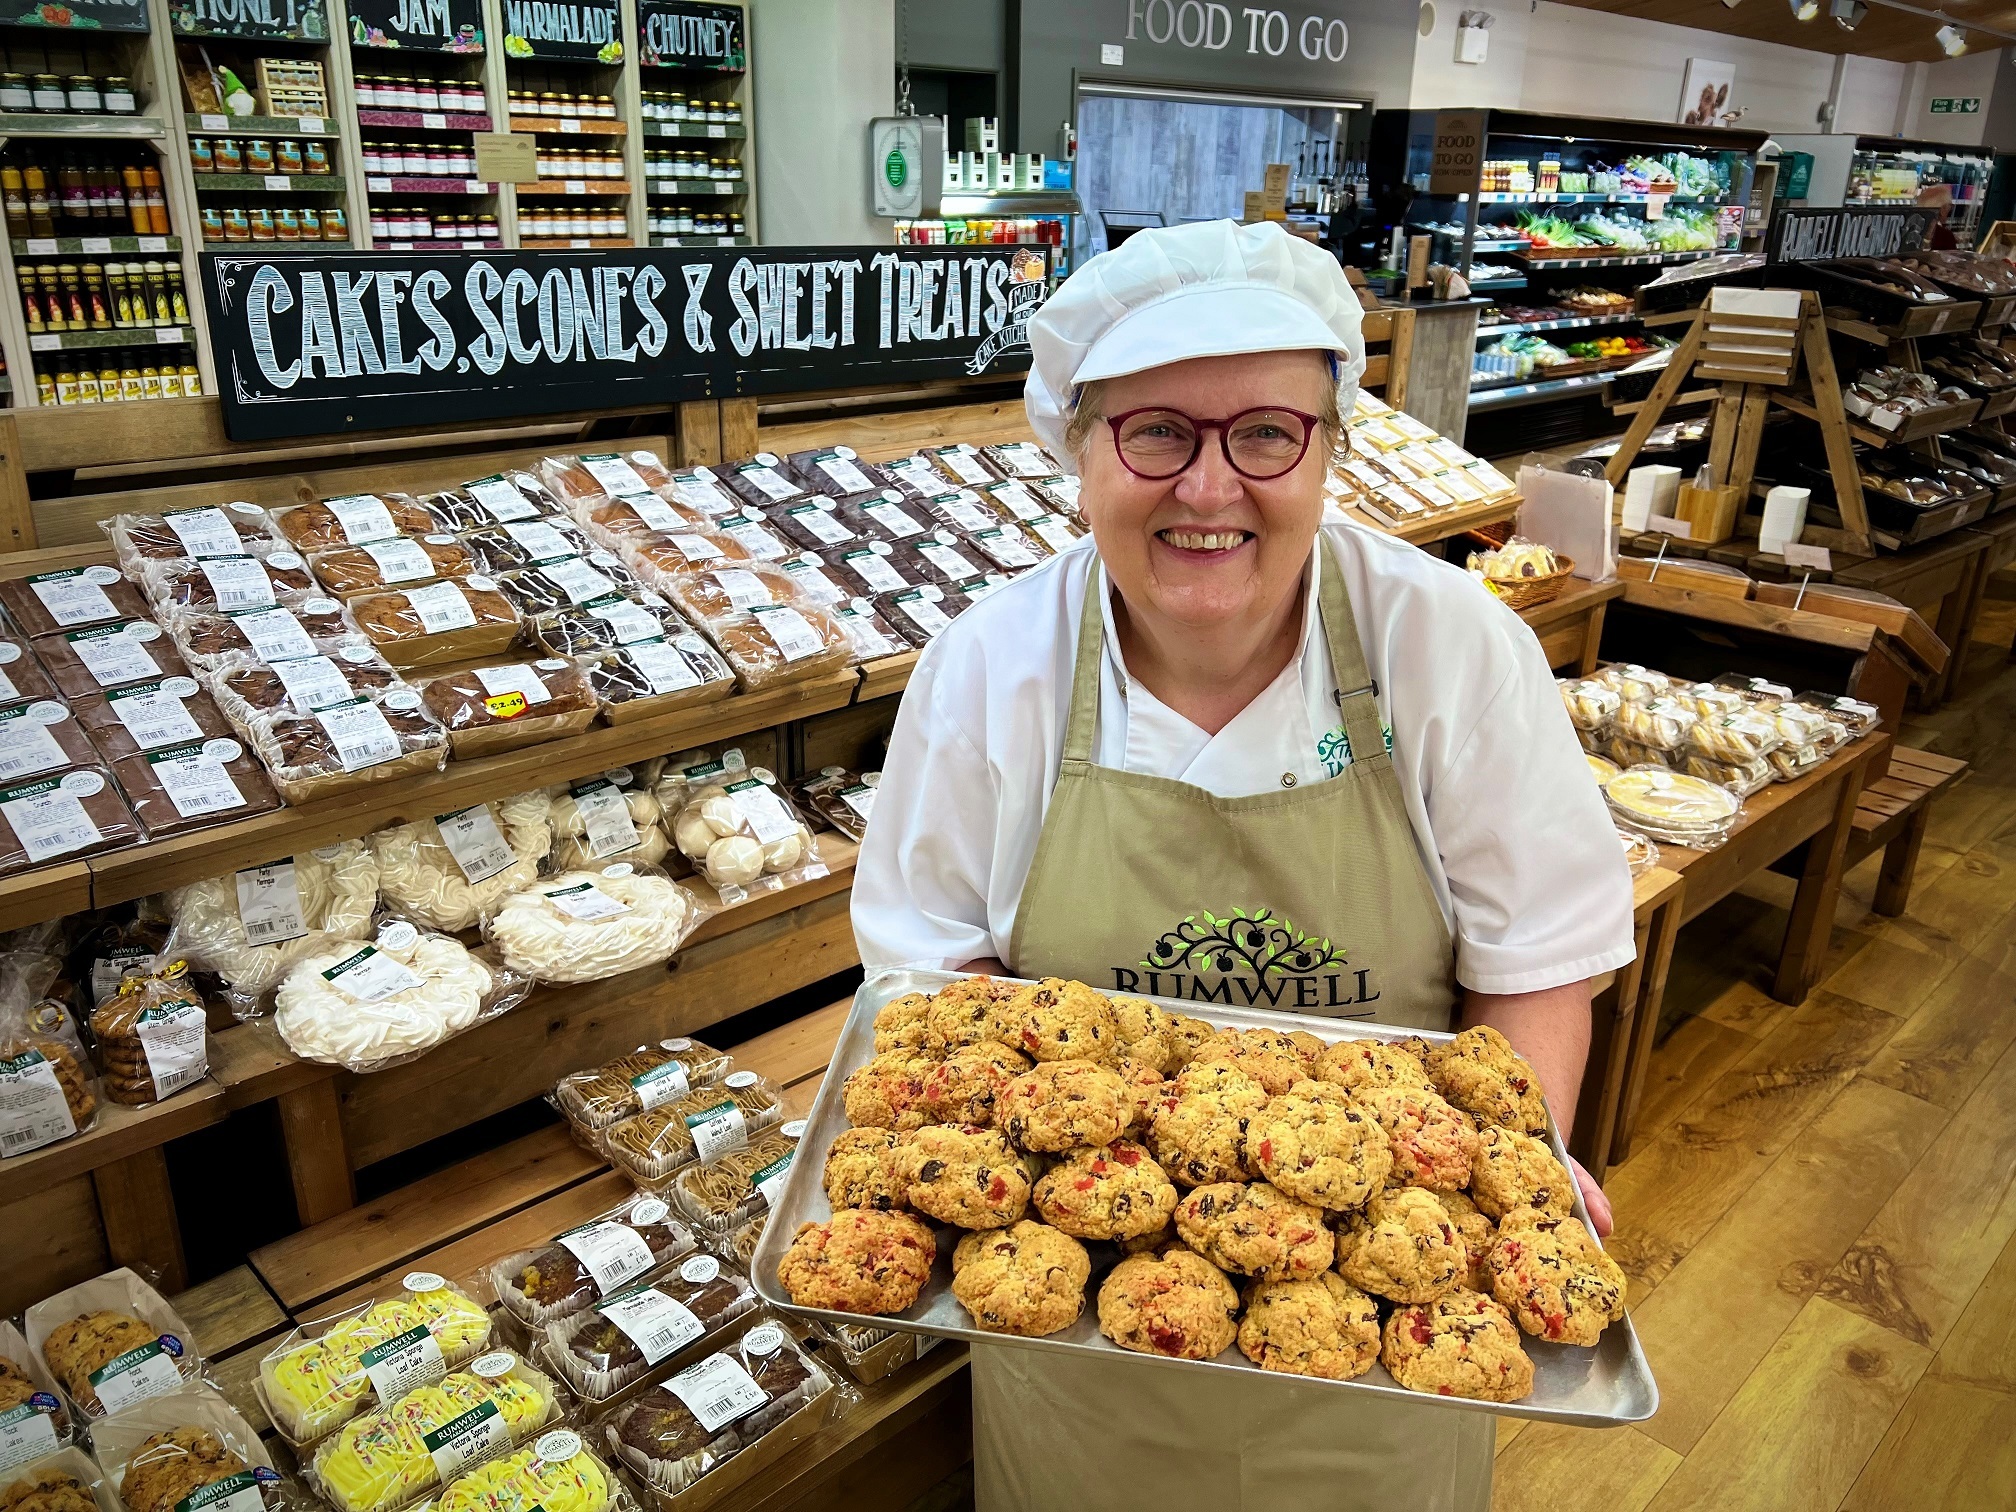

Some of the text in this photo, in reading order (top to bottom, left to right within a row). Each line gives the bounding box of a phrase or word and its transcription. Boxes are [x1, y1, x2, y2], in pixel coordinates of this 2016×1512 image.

[388, 0, 452, 37] JAM
[503, 0, 619, 45] MARMALADE
[646, 12, 736, 58] CHUTNEY
[1124, 0, 1349, 63] FOOD TO GO
[1436, 135, 1476, 149] FOOD
[1435, 152, 1474, 166] TO GO
[1013, 284, 1038, 306] MADE
[464, 260, 668, 376] SCONES
[681, 262, 716, 354] &
[728, 256, 863, 358] SWEET
[869, 251, 1009, 350] TREATS
[977, 324, 1029, 365] CAKE KITCHE
[36, 569, 78, 581] RUMWELL
[76, 626, 118, 638] RUMWELL
[116, 684, 159, 697] RUMWELL
[490, 698, 523, 710] £2.49
[159, 747, 202, 759] RUMWELL
[690, 762, 719, 774] RUMWELL
[7, 781, 57, 798] RUMWELL
[577, 780, 606, 794] RUMWELL
[730, 779, 757, 791] RUMWELL
[110, 945, 145, 957] MWELL
[331, 952, 368, 975] RUMWELL
[1111, 966, 1381, 1008] RUMWELL
[147, 1008, 196, 1029] Stem Ginger Biscuits
[639, 1064, 672, 1082] RUMWELL
[694, 1104, 728, 1122] RUMWELL
[759, 1156, 792, 1178] RUMWELL
[371, 1332, 418, 1359] RUMWELL
[102, 1347, 152, 1376] RUMWELL
[384, 1343, 424, 1368] Victoria Sponge
[128, 1367, 142, 1378] Rock
[395, 1356, 423, 1375] Loaf Cake
[131, 1376, 150, 1388] Cakes
[2, 1427, 18, 1436] Rock
[436, 1408, 485, 1441] RUMWELL
[464, 1419, 478, 1432] SHOP
[5, 1436, 24, 1448] Cakes
[449, 1422, 491, 1451] Victoria Sponge
[461, 1437, 490, 1459] Loaf Cake
[541, 1438, 576, 1457] RUMWELL
[188, 1476, 243, 1506] RUMWELL
[201, 1488, 233, 1506] FARM SHOP
[214, 1498, 231, 1512] Rock
